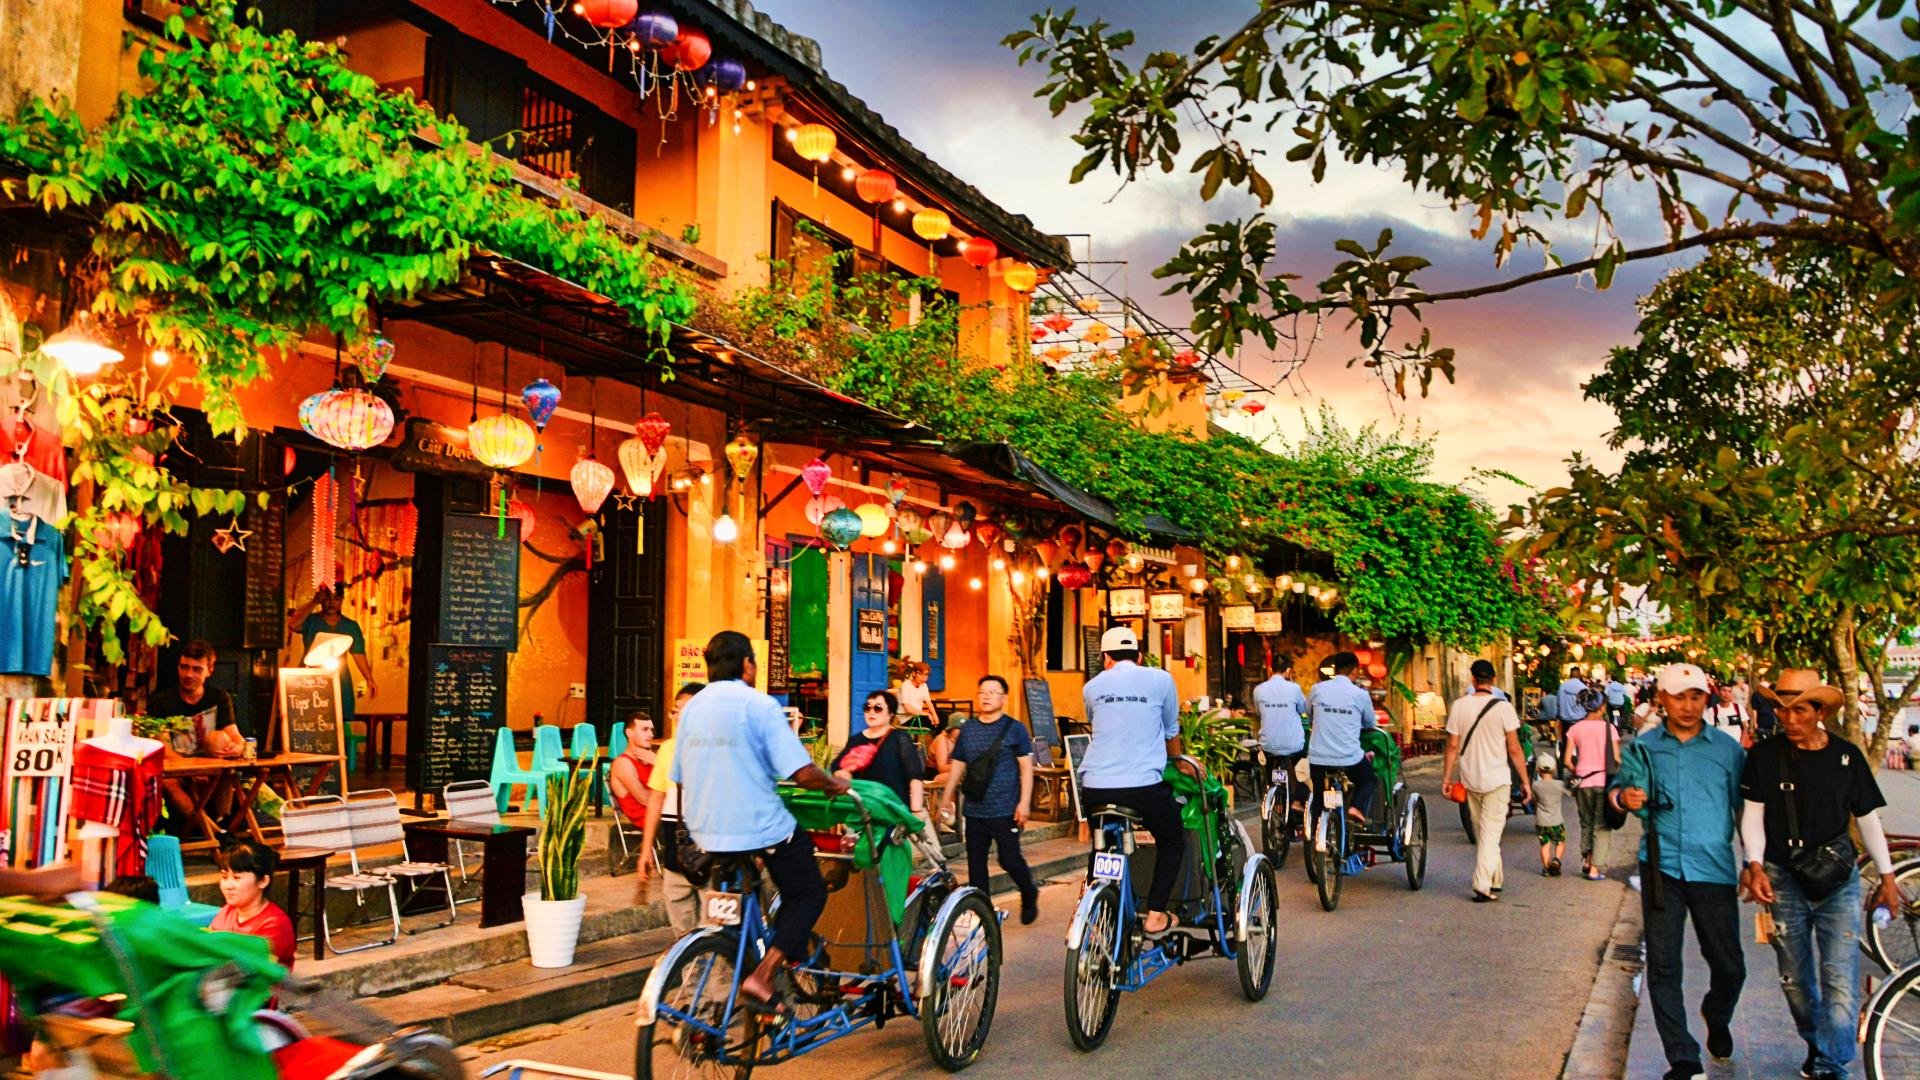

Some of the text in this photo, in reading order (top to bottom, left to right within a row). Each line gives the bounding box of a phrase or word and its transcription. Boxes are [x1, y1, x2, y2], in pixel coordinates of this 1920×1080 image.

[43, 728, 66, 744] SALE
[13, 749, 54, 772] 80
[1273, 770, 1287, 780] 067
[1096, 857, 1121, 875] 009
[708, 897, 738, 919] 022
